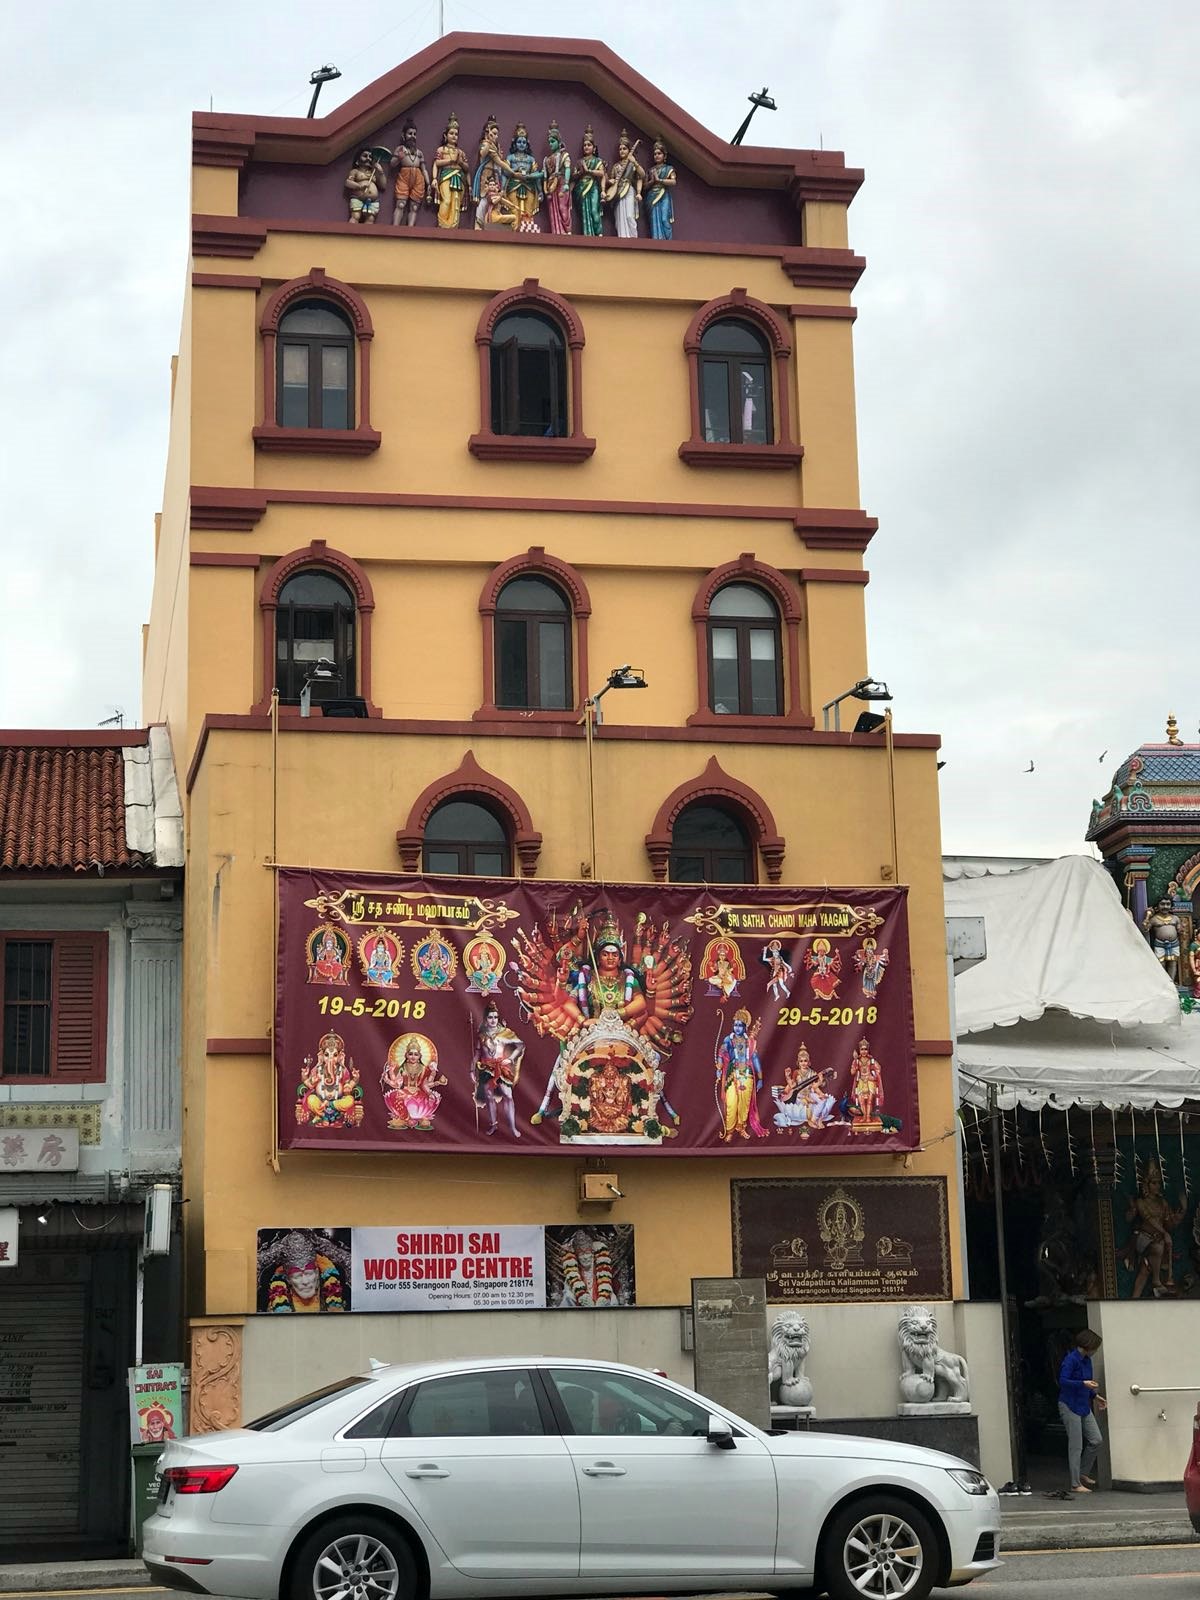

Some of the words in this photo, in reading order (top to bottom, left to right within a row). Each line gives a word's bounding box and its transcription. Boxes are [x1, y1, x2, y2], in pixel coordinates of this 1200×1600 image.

[352, 896, 365, 921] ஸ்ரீ
[367, 902, 383, 919] சத
[385, 898, 414, 919] சண்டி
[728, 914, 740, 927] SRI
[742, 914, 766, 928] SATHA
[768, 914, 796, 928] CHANDI
[798, 913, 818, 927] MAHA
[820, 912, 849, 926] YAAGAM
[318, 996, 426, 1019] 19-5-2018
[777, 1006, 878, 1025] 29-5-2018
[397, 1233, 464, 1255] SHIRDI
[468, 1232, 500, 1254] SAI
[363, 1258, 457, 1281] WORSHIP
[462, 1257, 533, 1279] CENTRE
[365, 1282, 377, 1290] 3rd
[379, 1282, 397, 1290] Floor
[399, 1281, 411, 1289] 555
[412, 1281, 450, 1290] Serangoon
[452, 1281, 471, 1289] Road,
[473, 1280, 508, 1290] Singapore
[509, 1280, 533, 1288] 218174
[791, 1279, 836, 1288] Vadapathira
[837, 1278, 879, 1286] Kaliamman
[881, 1277, 908, 1286] Temple
[428, 1293, 452, 1301] Opening
[146, 1370, 163, 1379] SAI
